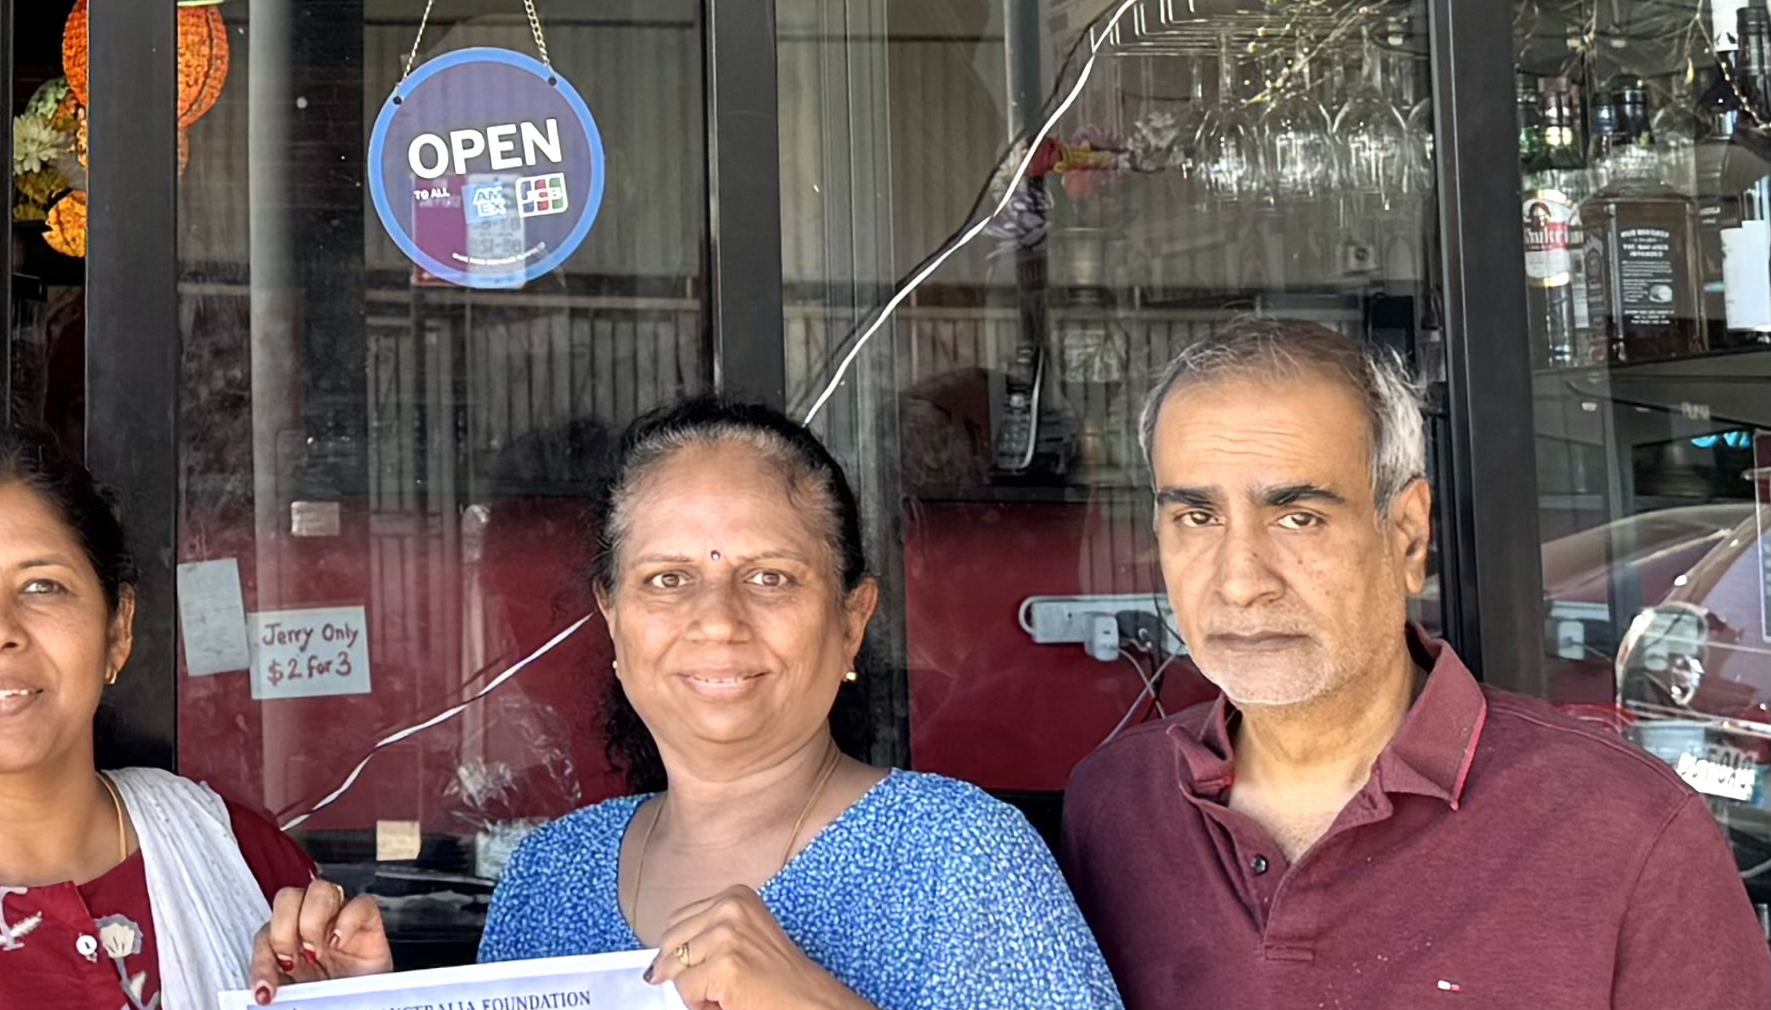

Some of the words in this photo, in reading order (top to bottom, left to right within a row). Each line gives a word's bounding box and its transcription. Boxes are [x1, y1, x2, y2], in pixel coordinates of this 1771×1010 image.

[408, 118, 562, 179] OPEN
[414, 190, 428, 200] TO
[431, 187, 450, 198] ALL
[525, 188, 563, 201] JCB
[262, 623, 314, 652] Jerry
[322, 623, 358, 648] Only
[335, 650, 352, 676] 3
